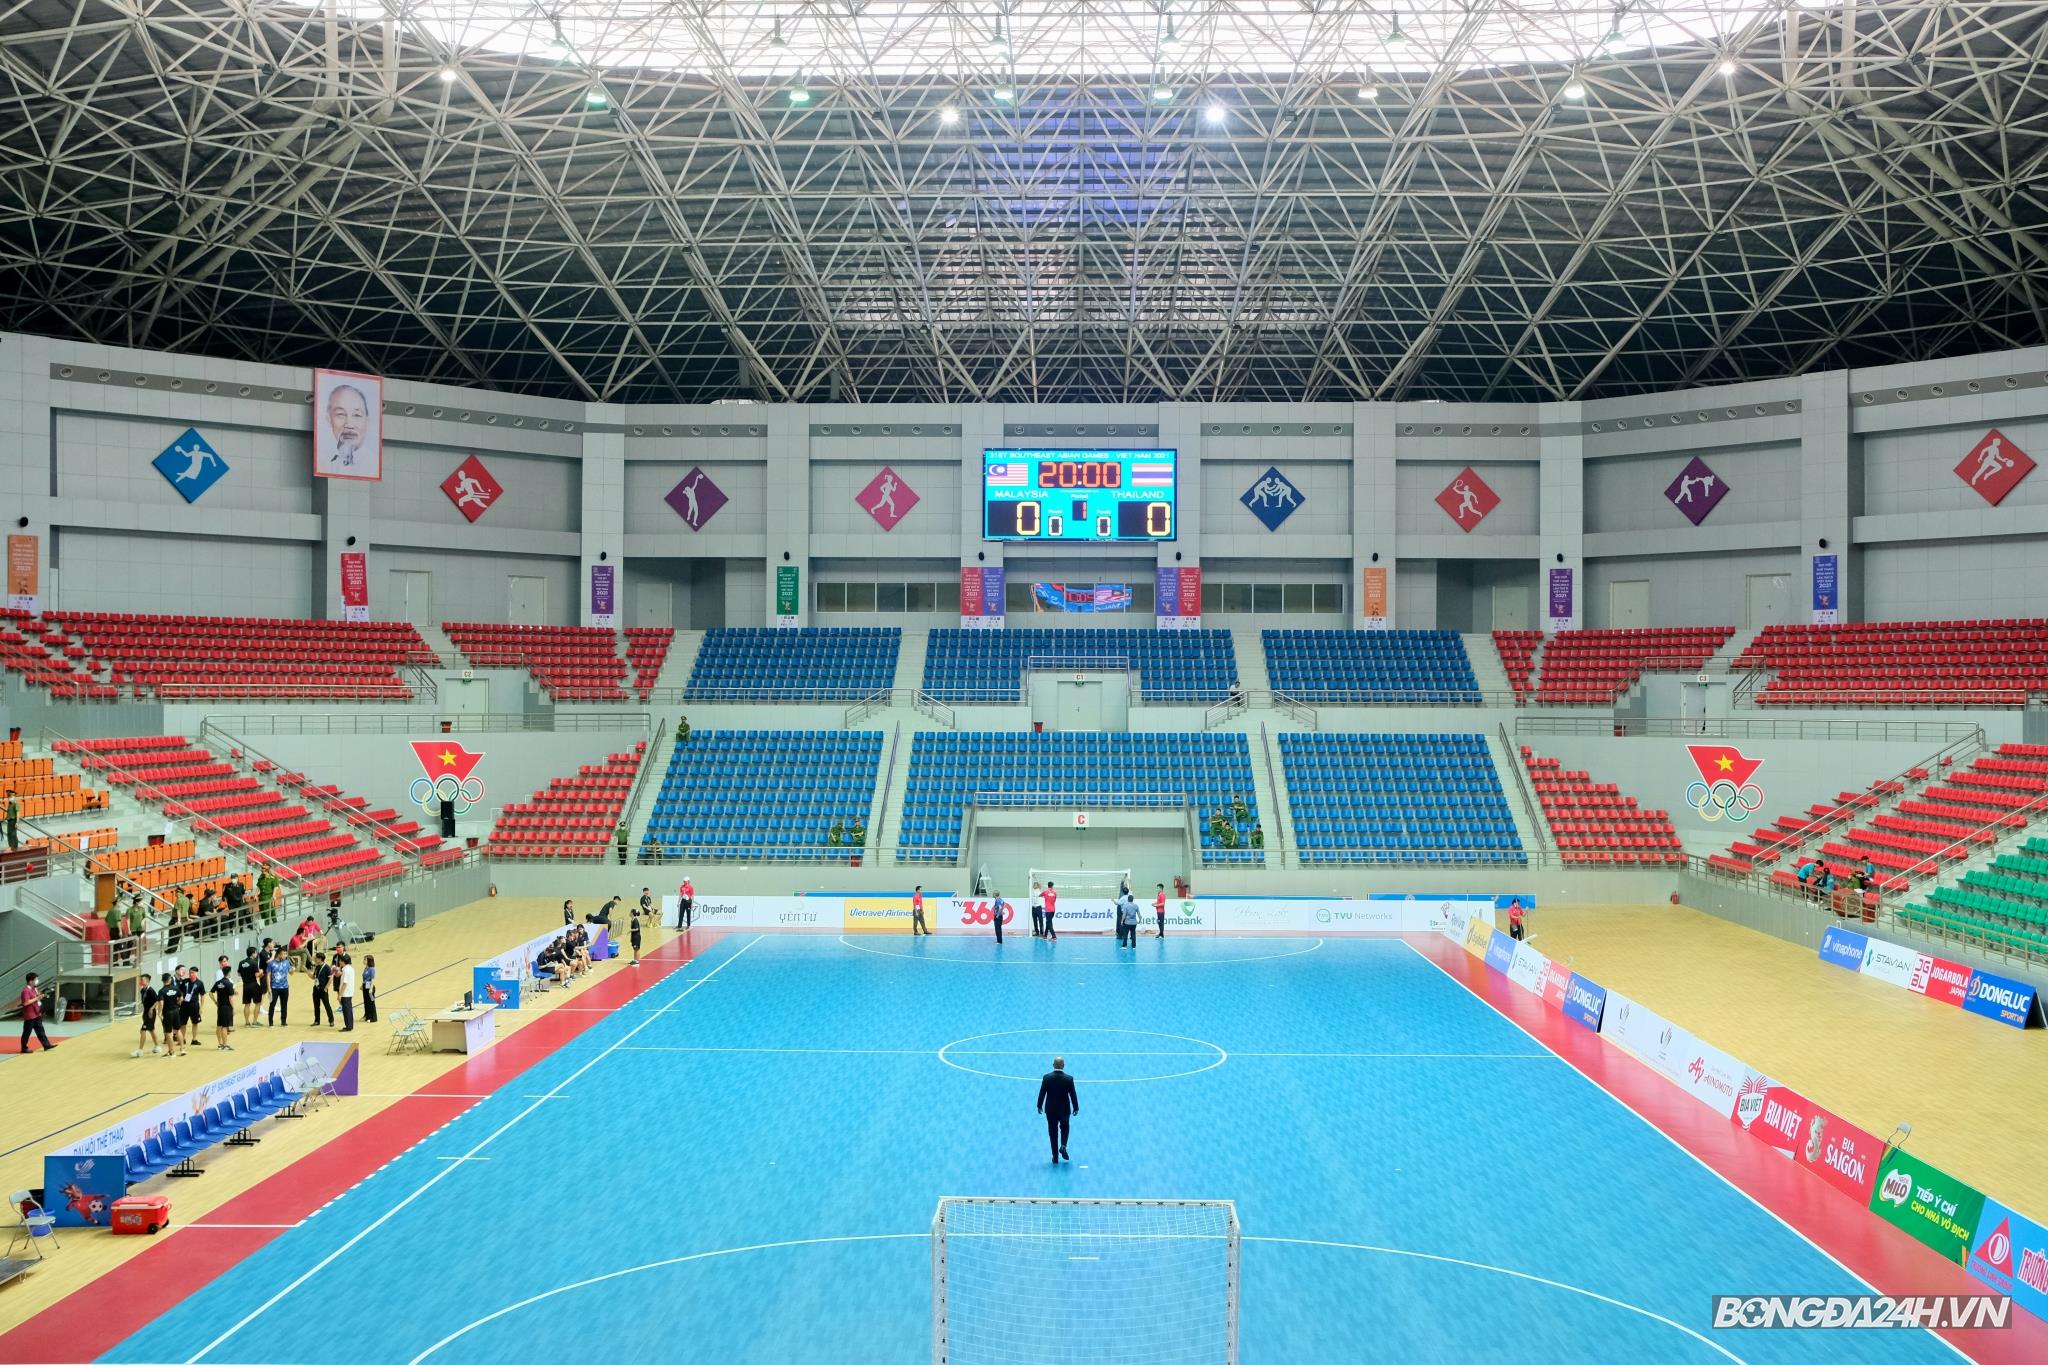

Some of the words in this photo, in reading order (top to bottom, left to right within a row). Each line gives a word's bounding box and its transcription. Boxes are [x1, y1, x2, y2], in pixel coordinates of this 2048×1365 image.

[1039, 462, 1121, 487] 20:00
[994, 491, 1049, 499] MALAYSIA
[1111, 491, 1165, 499] THAILAND
[1016, 501, 1040, 536] 0
[1048, 516, 1063, 536] 0
[1097, 516, 1111, 536] 0
[1147, 502, 1171, 537] 0
[1077, 814, 1086, 825] C
[702, 904, 737, 915] OrgaFood
[849, 907, 885, 917] Vietravel
[1334, 912, 1353, 920] TVU
[1354, 912, 1393, 920] Networks
[1832, 939, 1863, 959] vinaphone
[1875, 953, 1911, 971] STAVIAN
[1930, 968, 1969, 990] JOGARBOLA
[1572, 986, 1602, 1015] DONGLUC
[1948, 985, 1967, 999] JAPAN
[1979, 982, 2031, 1013] DONGLUC
[1764, 1099, 1781, 1129] BIA
[1841, 1137, 1856, 1155] BIA
[1883, 1178, 1908, 1198] MILO
[1911, 1200, 1925, 1215] CHO
[1916, 1185, 1934, 1204] TIẾP
[1935, 1194, 1942, 1207] Ý
[1941, 1200, 1959, 1216] CHÍ
